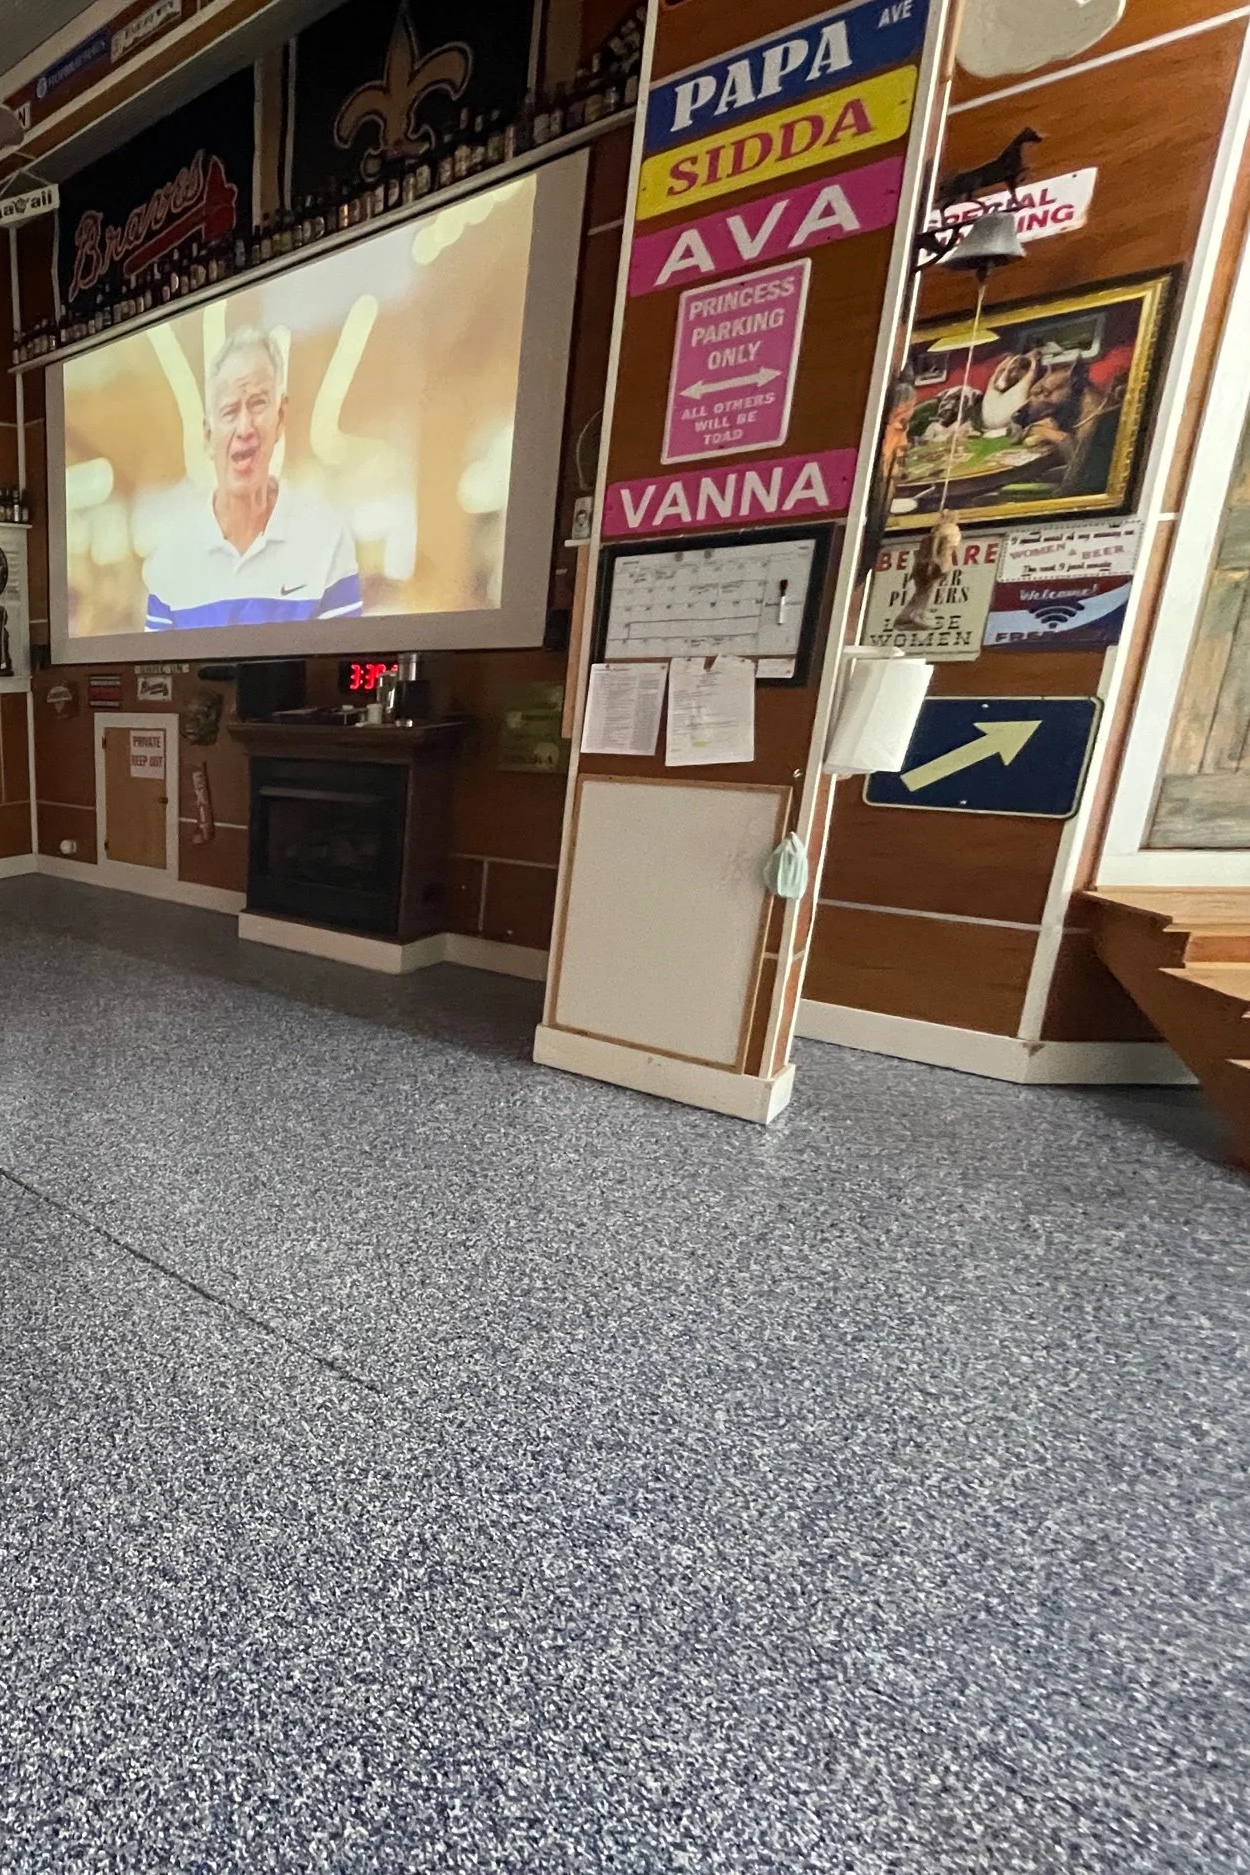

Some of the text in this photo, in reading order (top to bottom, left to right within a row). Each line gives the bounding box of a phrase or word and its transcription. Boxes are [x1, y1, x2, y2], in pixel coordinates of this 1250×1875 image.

[669, 0, 915, 133] PAPA AVE
[667, 98, 877, 197] SIDDA
[68, 148, 206, 303] Braves
[653, 184, 861, 288] AVA
[689, 276, 795, 321] PRINCESS
[692, 308, 785, 347] PARKING
[708, 341, 761, 370] ONLY
[681, 392, 775, 420] ALL OTHERS
[694, 410, 758, 432] WILL BE
[703, 429, 743, 445] TOAD
[620, 462, 829, 529] VANNA
[1010, 543, 1066, 560] WOMEN
[1082, 545, 1124, 559] BEER
[1020, 584, 1098, 601] Welcome!
[870, 631, 972, 648] WOMEN
[133, 736, 161, 749] PRIVATE
